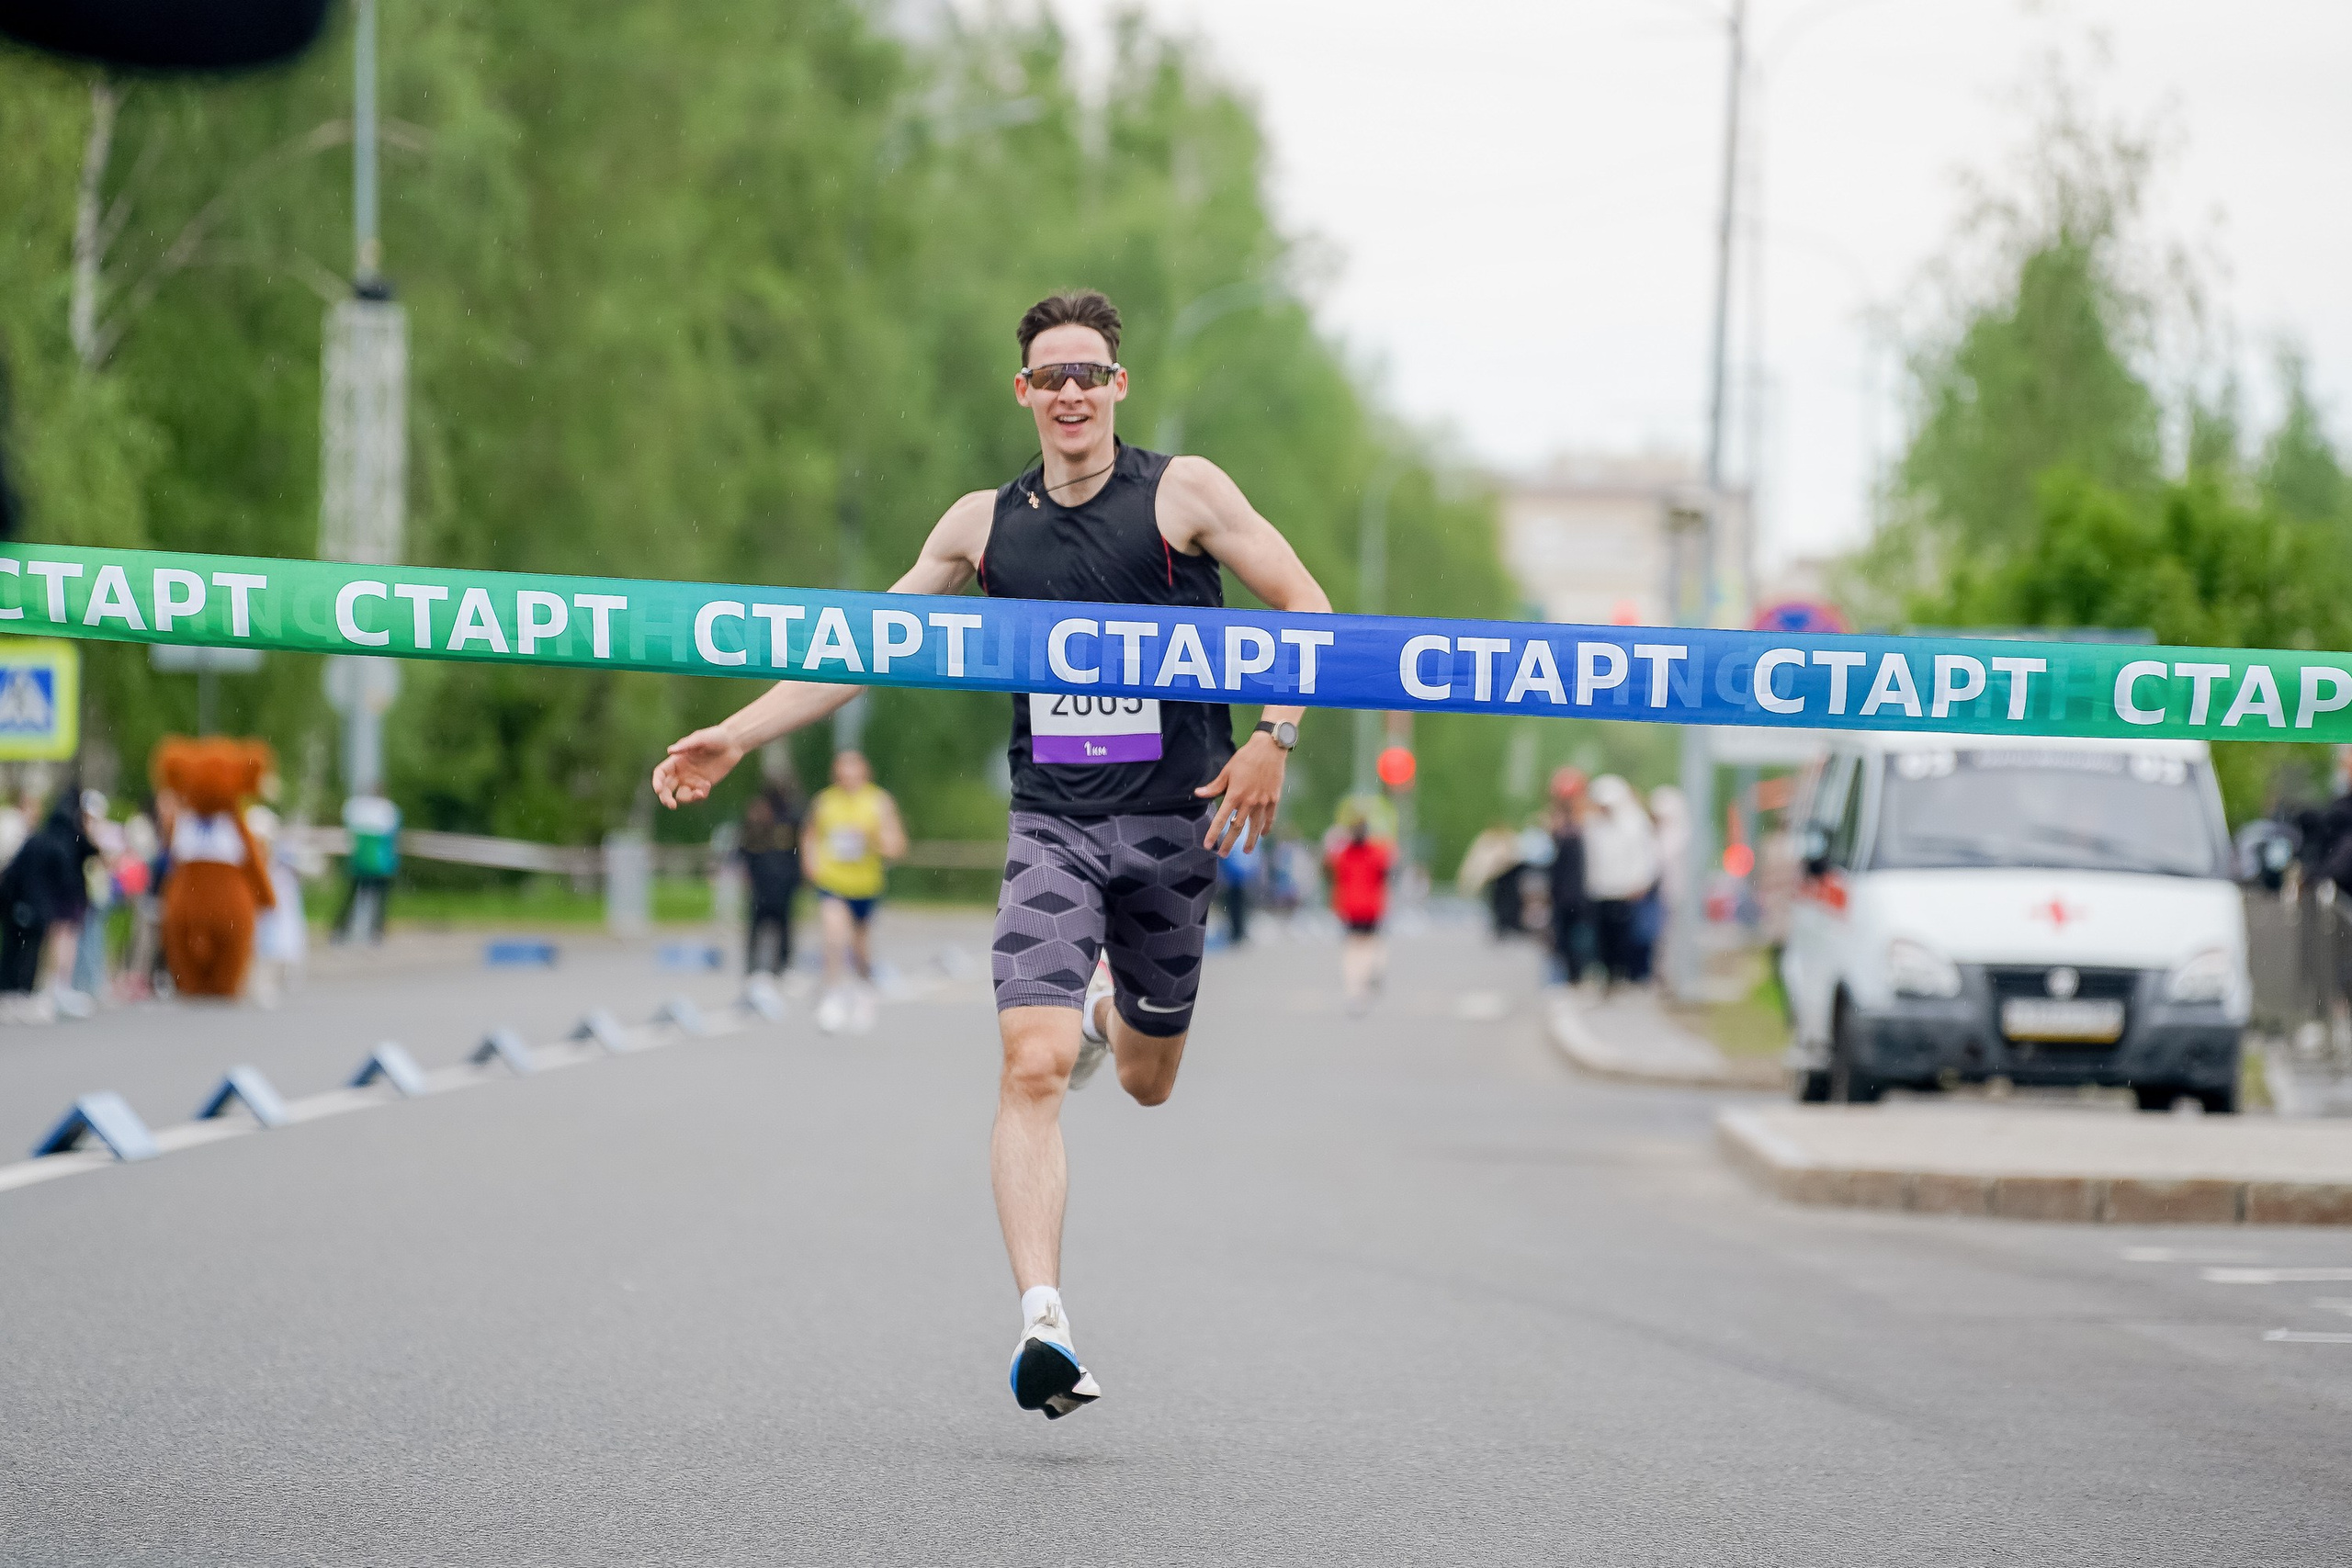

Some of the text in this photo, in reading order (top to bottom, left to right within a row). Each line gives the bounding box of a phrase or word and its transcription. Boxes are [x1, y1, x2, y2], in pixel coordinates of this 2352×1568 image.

[334, 580, 628, 653] СТАРТ
[694, 600, 982, 670] СТАРТ
[1047, 617, 1334, 685] СТАРТ
[1399, 634, 1688, 702] СТАРТ
[1753, 648, 2047, 718] СТАРТ
